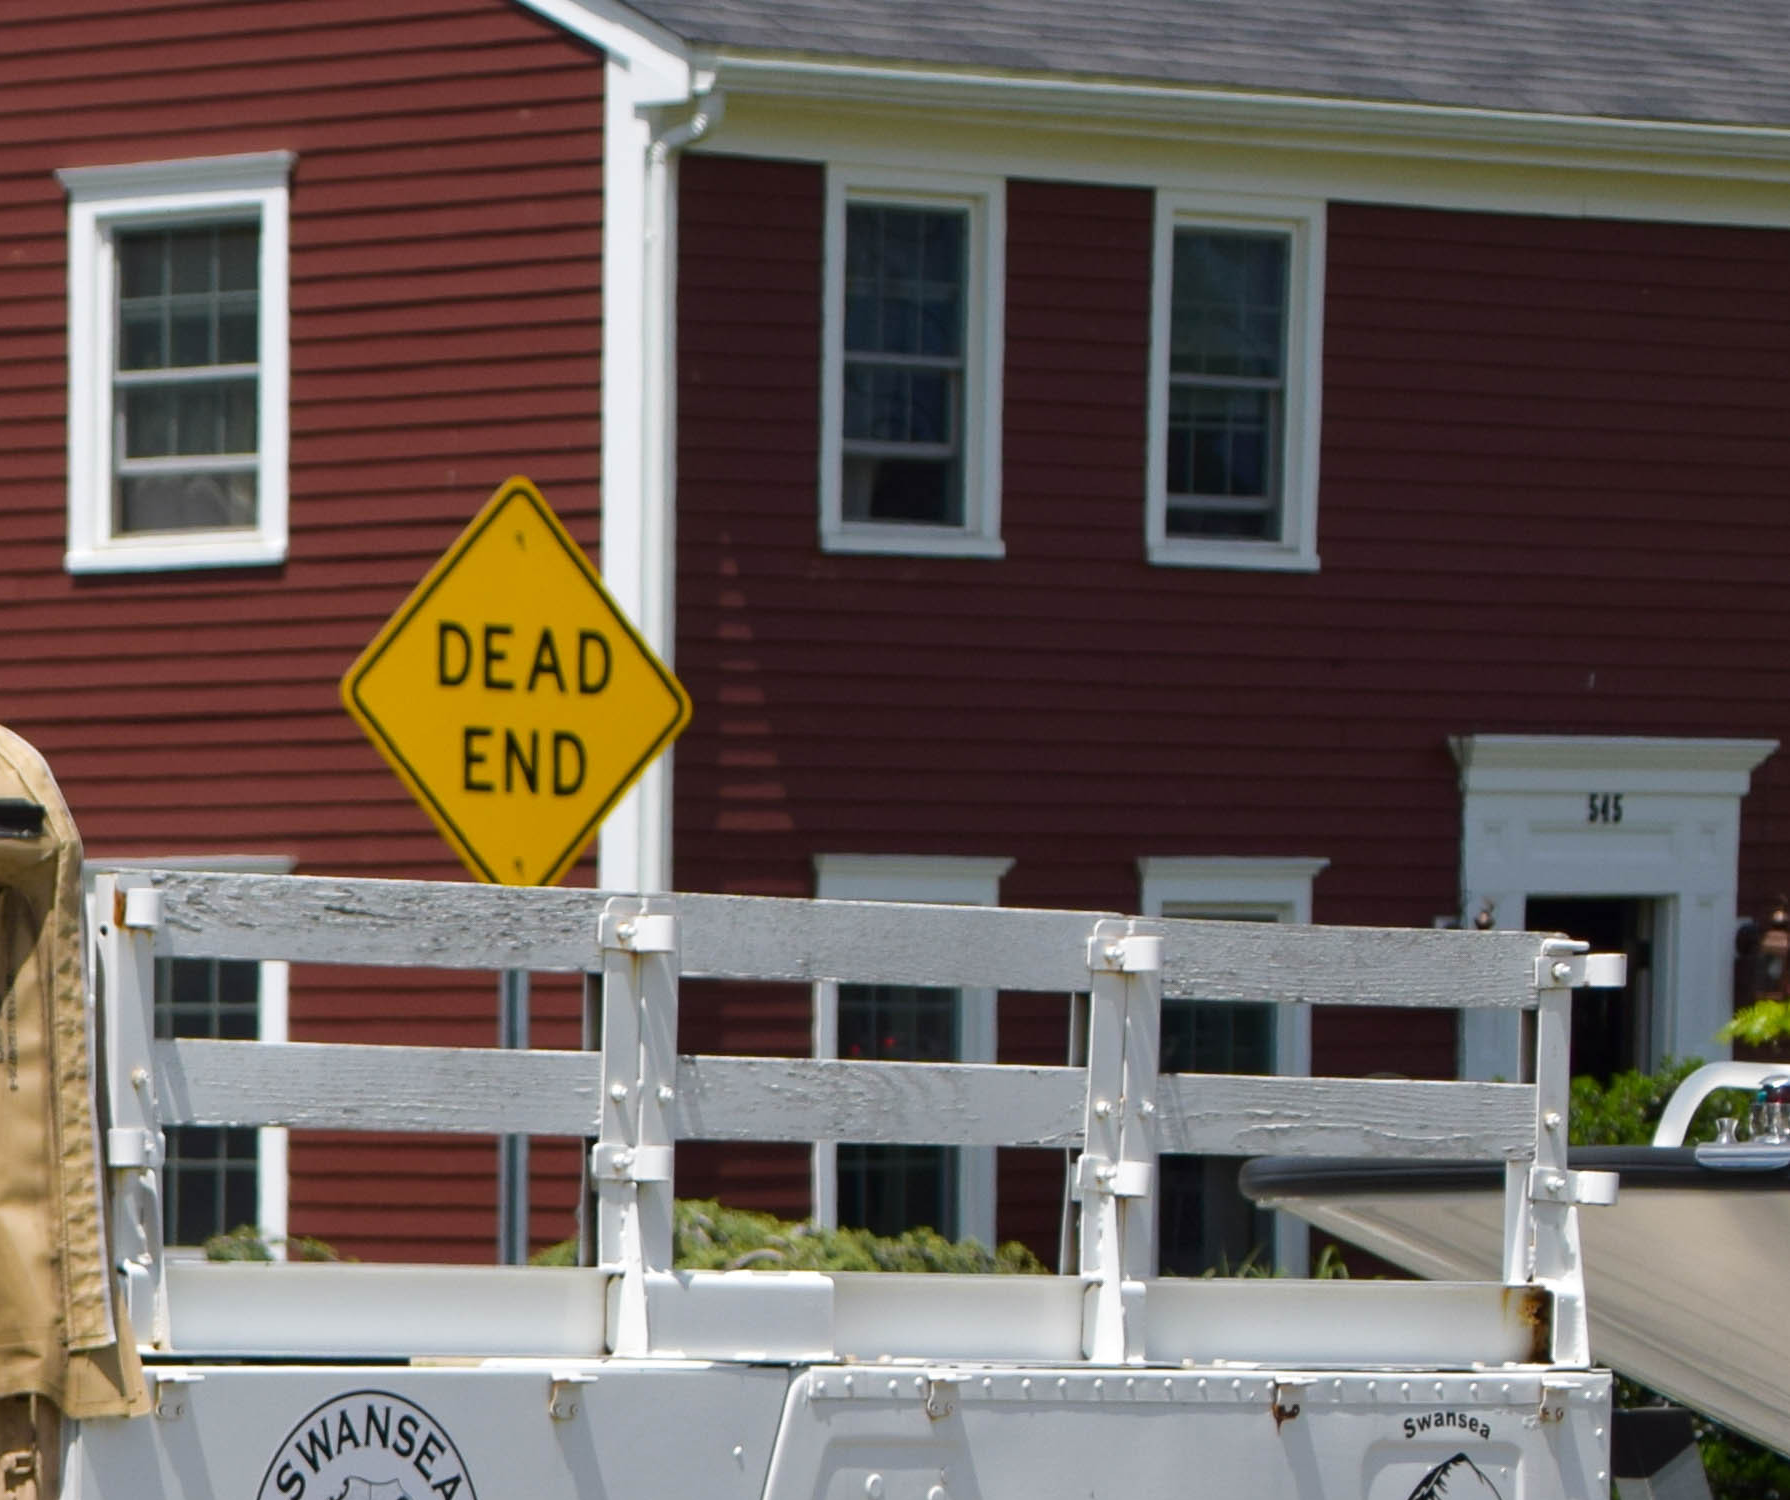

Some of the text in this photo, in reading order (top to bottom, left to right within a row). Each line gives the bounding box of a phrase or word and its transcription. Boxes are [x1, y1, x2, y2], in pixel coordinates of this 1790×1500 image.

[437, 620, 614, 695] DEAD
[462, 726, 588, 797] END
[1402, 1410, 1493, 1441] Swansea
